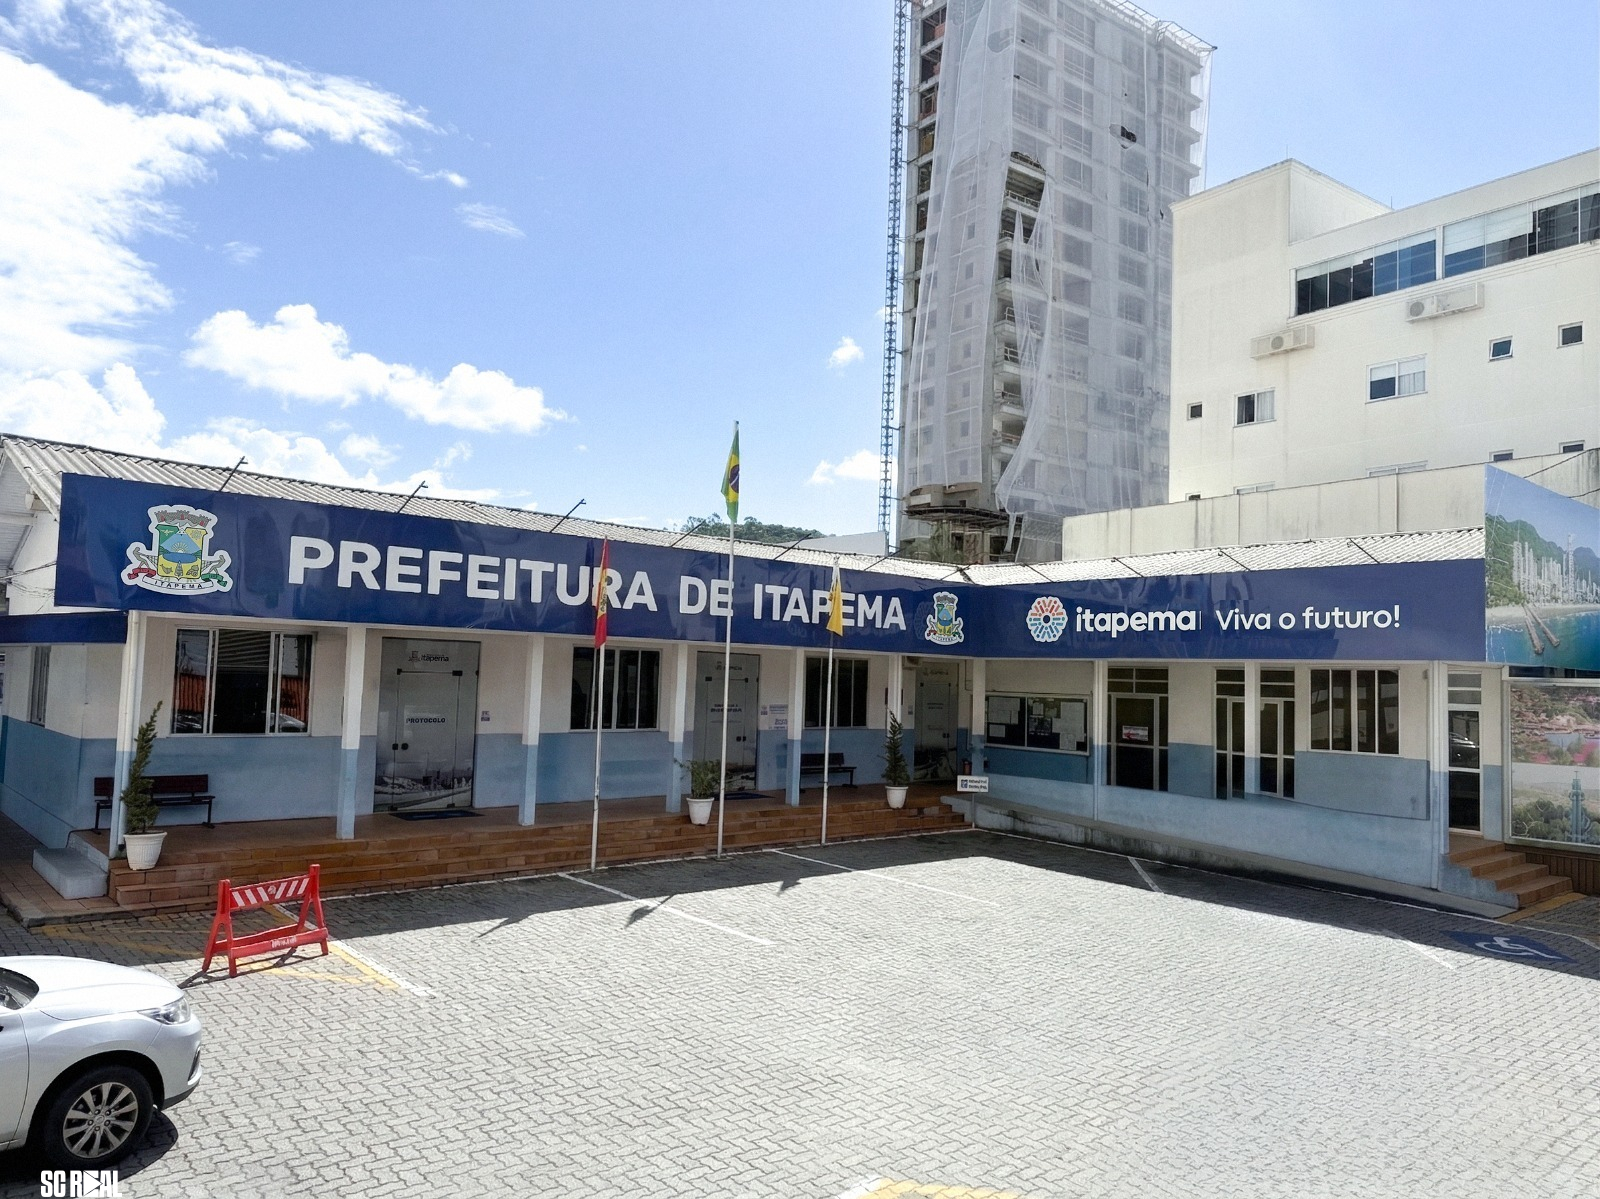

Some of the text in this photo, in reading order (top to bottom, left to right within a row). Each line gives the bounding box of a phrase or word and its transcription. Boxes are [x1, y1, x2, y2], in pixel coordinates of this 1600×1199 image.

[154, 581, 203, 589] ITAPEMA
[288, 535, 907, 631] PREFEITURA DE ITAPEMA
[1075, 604, 1401, 638] itapema Viva o futuro!
